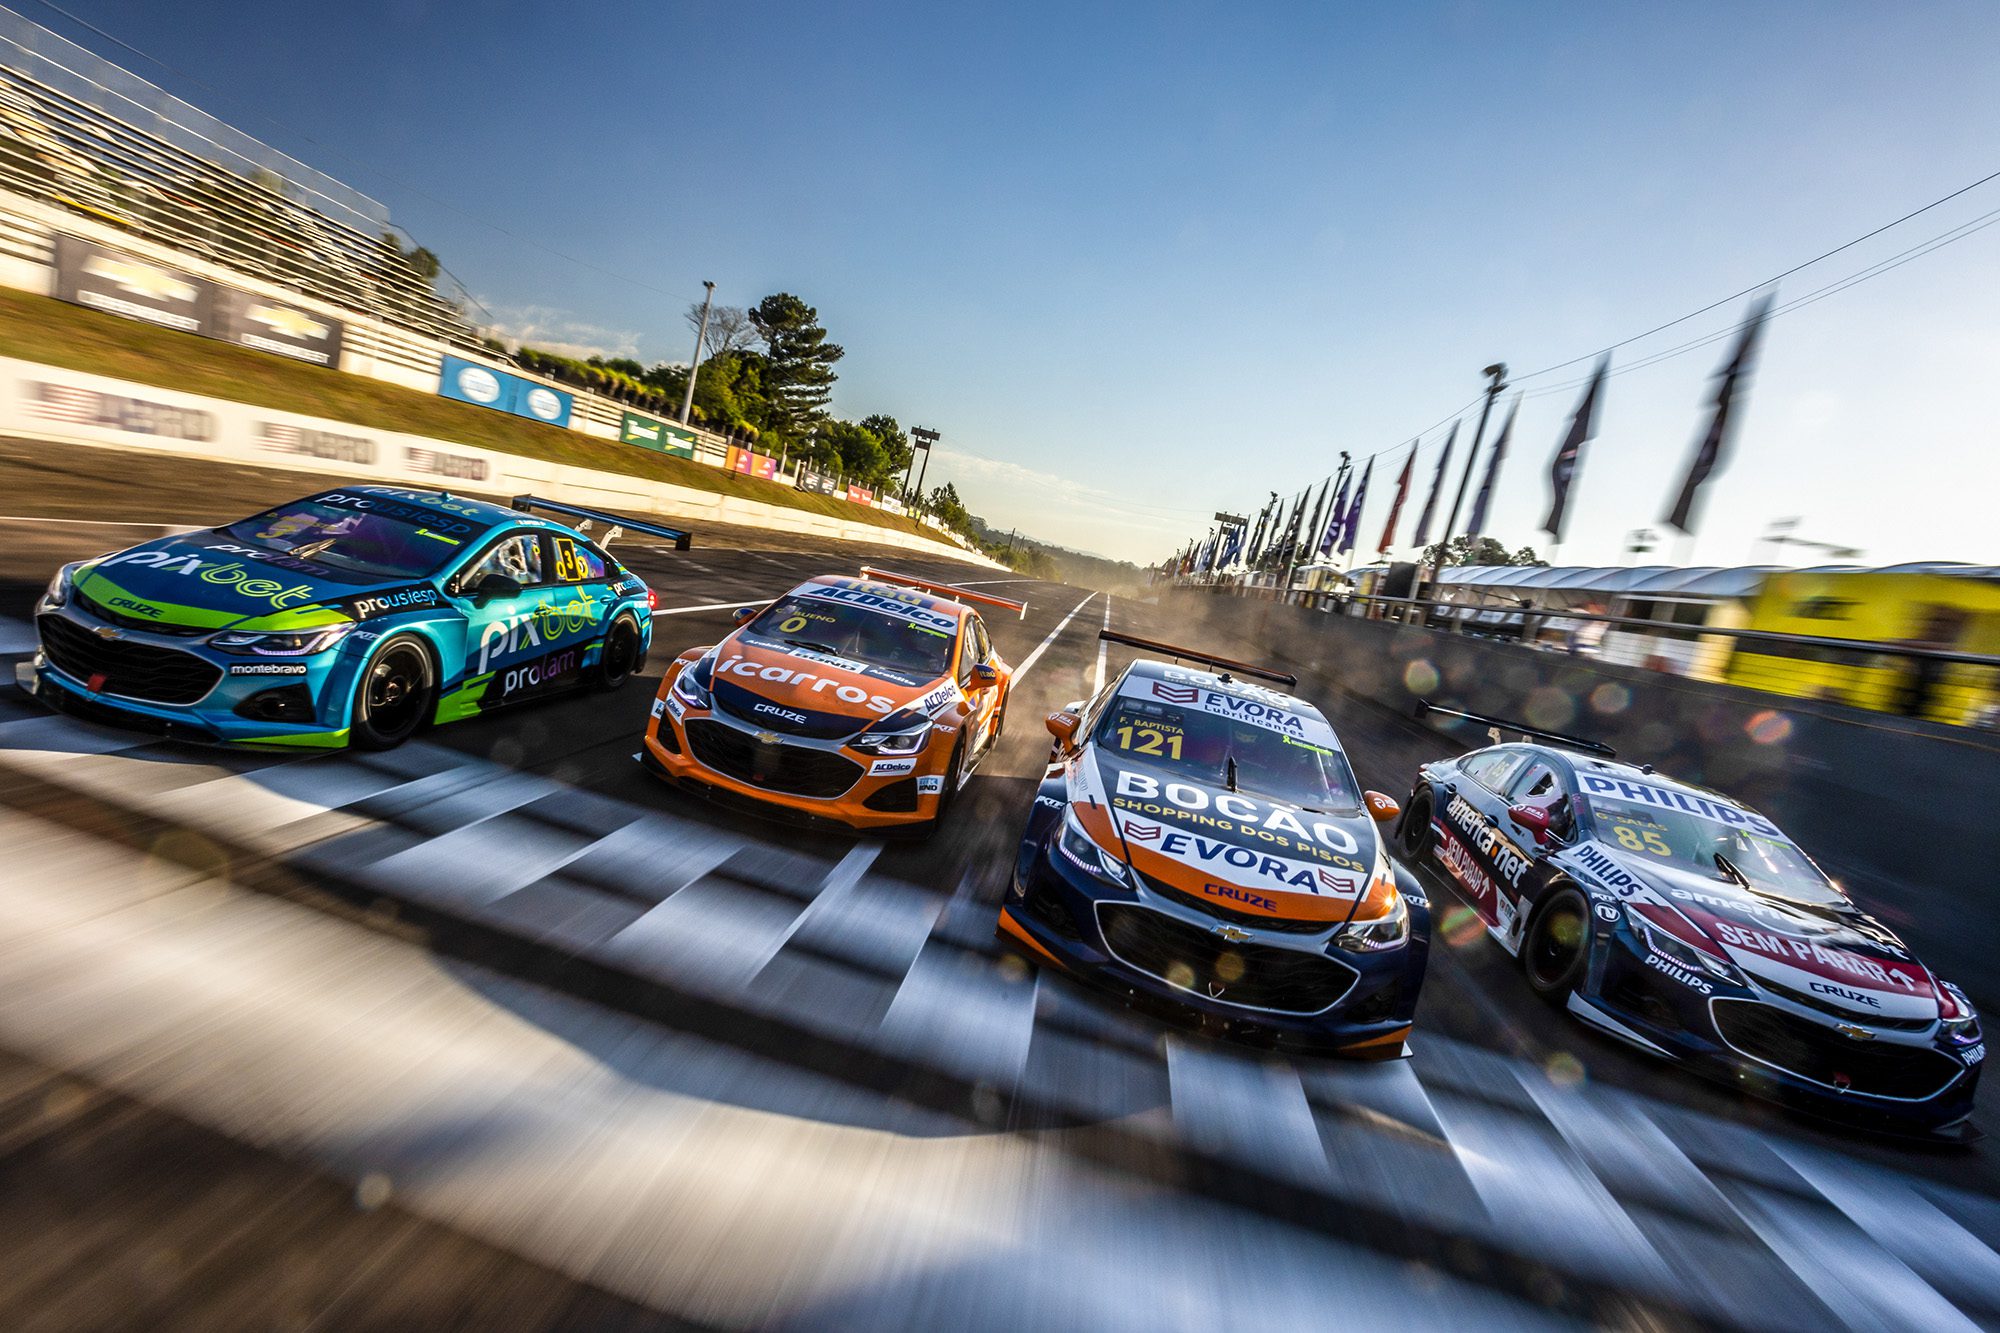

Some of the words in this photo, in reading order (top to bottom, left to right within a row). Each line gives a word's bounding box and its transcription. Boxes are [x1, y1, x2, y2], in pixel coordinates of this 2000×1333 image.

[314, 494, 471, 533] prousiesp
[204, 544, 329, 576] prolam
[101, 551, 314, 609] pixbet
[109, 597, 164, 618] CRUZE
[354, 588, 438, 618] prousiesp
[793, 611, 836, 623] BUENO
[812, 587, 955, 628] ACDelco
[478, 585, 597, 675] pixbet
[231, 664, 306, 674] montebravo
[503, 650, 575, 697] prolam
[717, 655, 896, 714] icarros
[754, 703, 807, 724] CRUZE
[924, 685, 956, 711] ACDelco
[1206, 693, 1303, 730] EVORA
[1119, 716, 1129, 724] F.
[1134, 719, 1184, 735] BAPTISTA
[1205, 704, 1304, 738] Lubrificantes
[1117, 726, 1183, 760] 121
[874, 763, 911, 771] ACDelco
[1116, 770, 1359, 854] BOCÃO
[1584, 776, 1779, 837] PHILIPS
[1113, 797, 1233, 831] SHOPPING
[1240, 824, 1290, 847] DOS
[1297, 842, 1365, 872] PISOS
[1613, 825, 1672, 856] 85
[1160, 833, 1319, 894] EVORA
[1573, 845, 1643, 897] PHILIPS
[1204, 883, 1277, 912] CRUZE
[1715, 922, 1789, 957] SEM
[1790, 938, 1896, 985] PARAR
[1644, 954, 1714, 994] PHILIPS
[1809, 981, 1881, 1008] CRUZE
